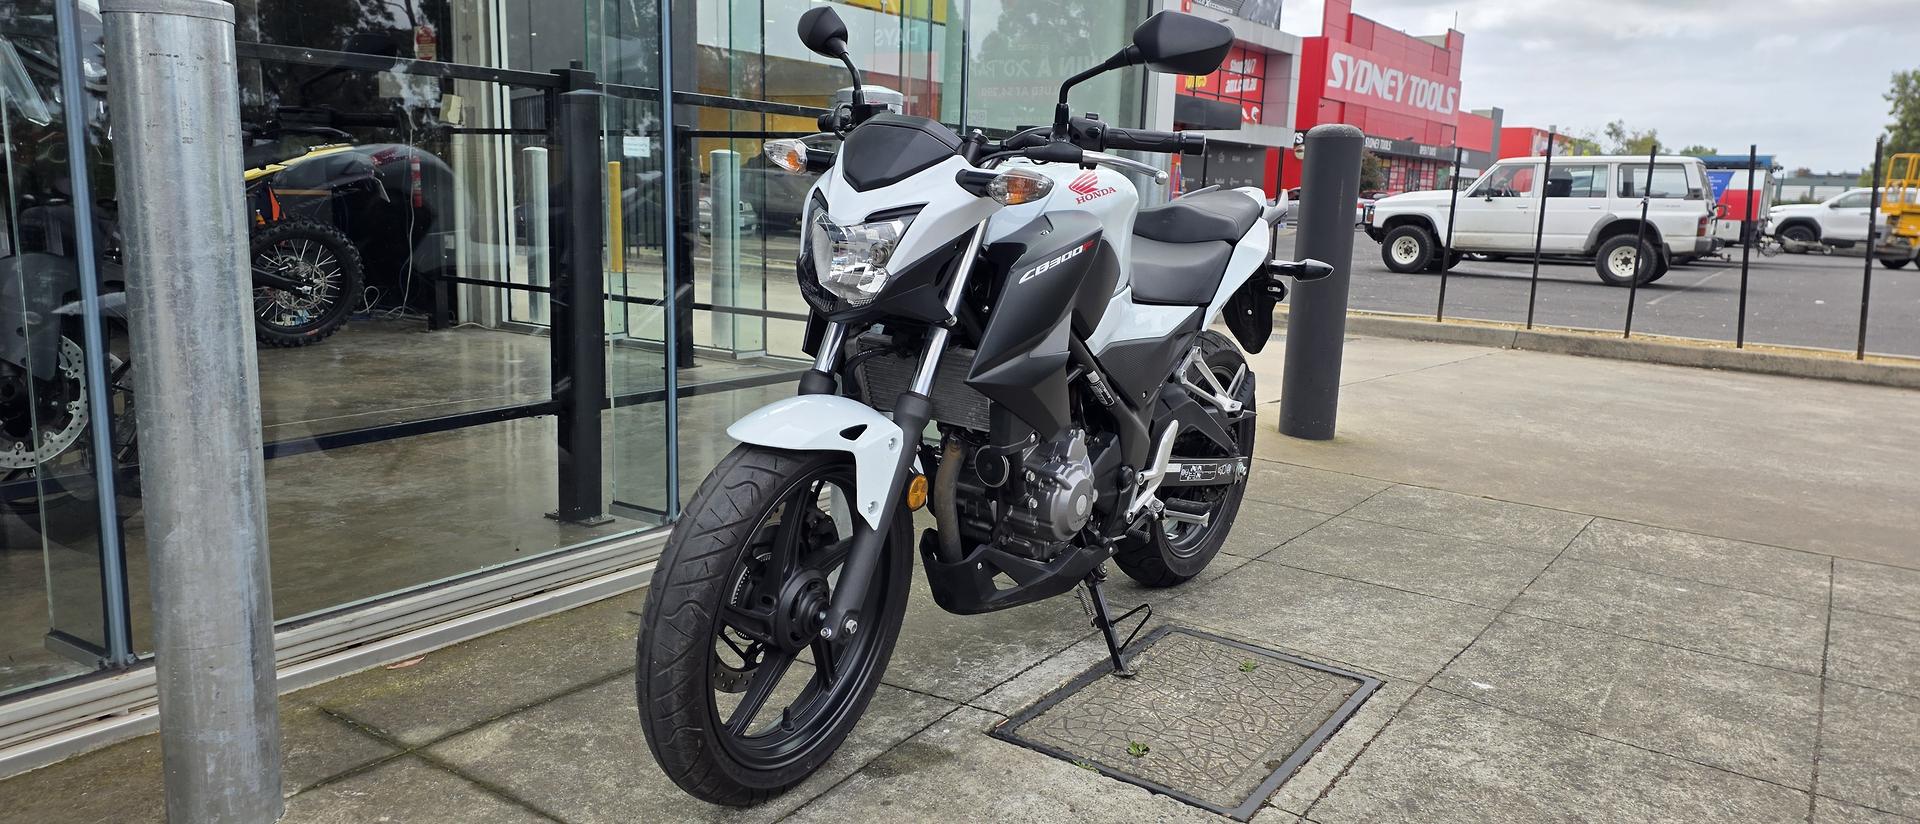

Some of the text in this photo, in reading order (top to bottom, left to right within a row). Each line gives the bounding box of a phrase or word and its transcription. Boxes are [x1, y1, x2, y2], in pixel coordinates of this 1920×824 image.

[1327, 52, 1456, 115] SYDNEY TOOLS
[1075, 186, 1117, 205] HONDA
[1018, 240, 1096, 285] CB300F
